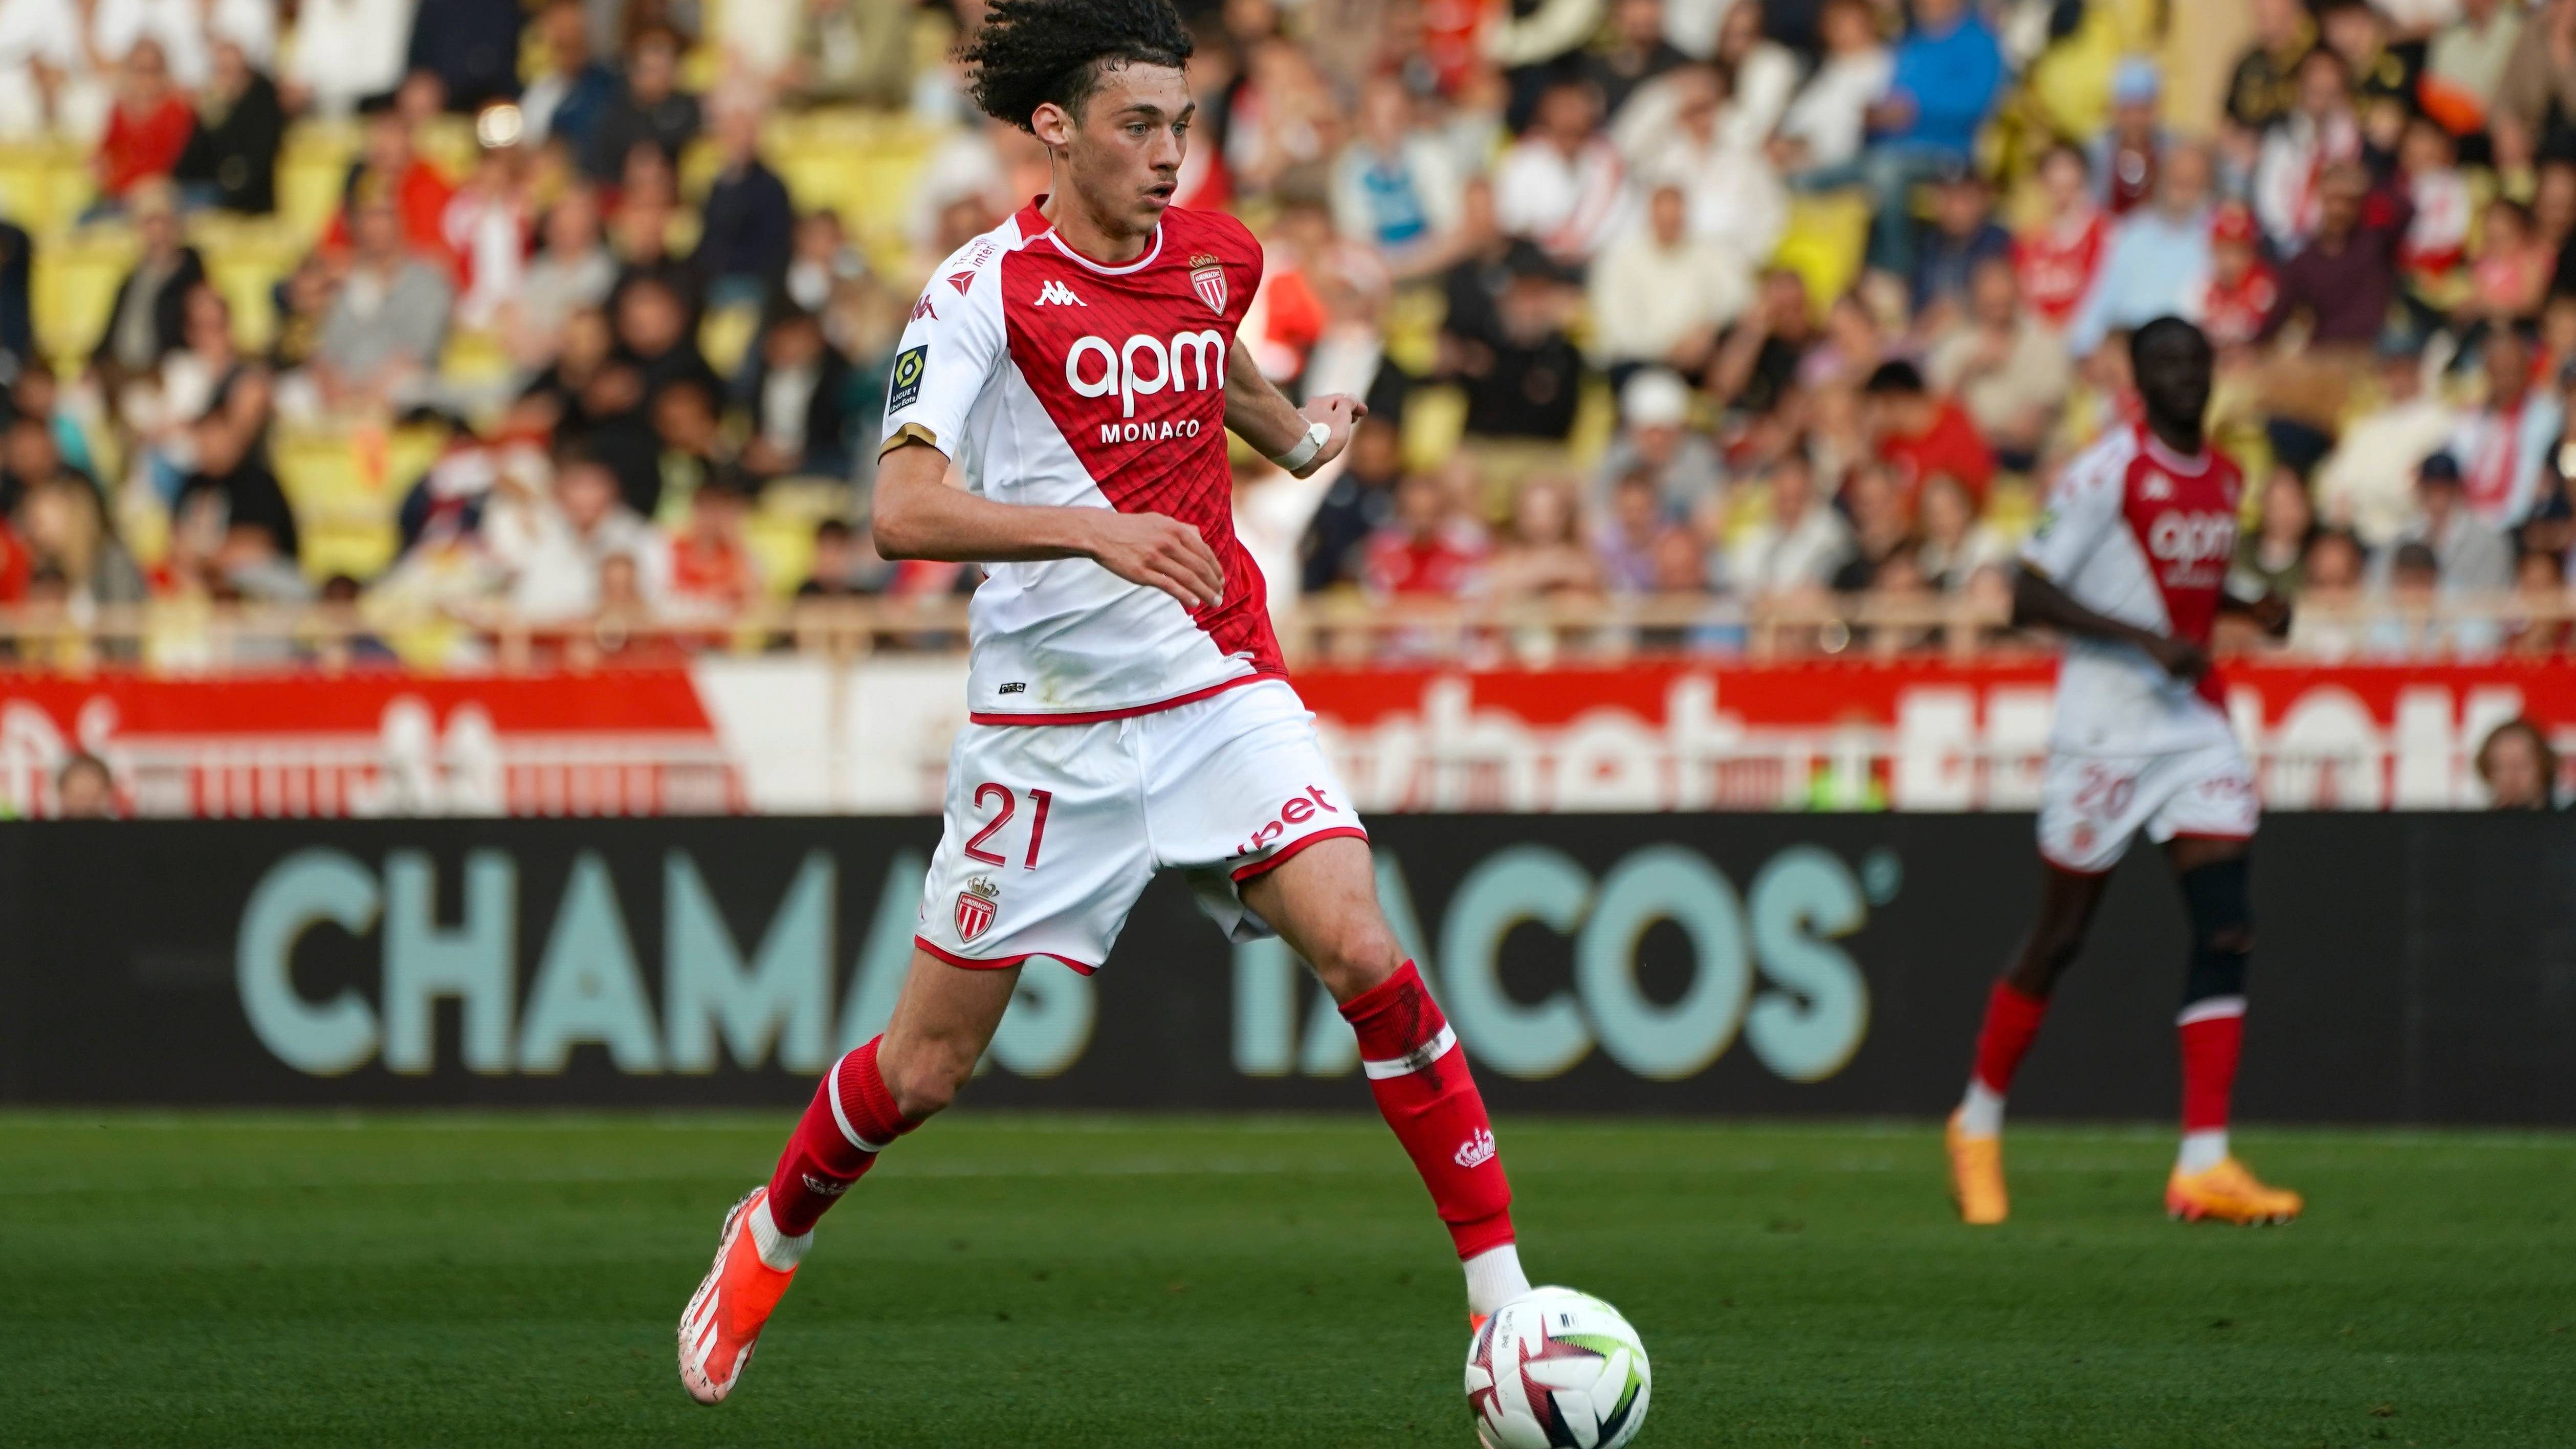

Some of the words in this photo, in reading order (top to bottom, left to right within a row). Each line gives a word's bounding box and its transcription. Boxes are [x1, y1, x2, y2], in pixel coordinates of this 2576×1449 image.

[892, 388, 912, 403] LIGUE
[1066, 330, 1226, 418] apm
[890, 403, 901, 412] Uber
[902, 397, 916, 406] Eats
[1101, 420, 1200, 444] MONACO
[965, 782, 1052, 871] 21
[1237, 784, 1338, 855] bet
